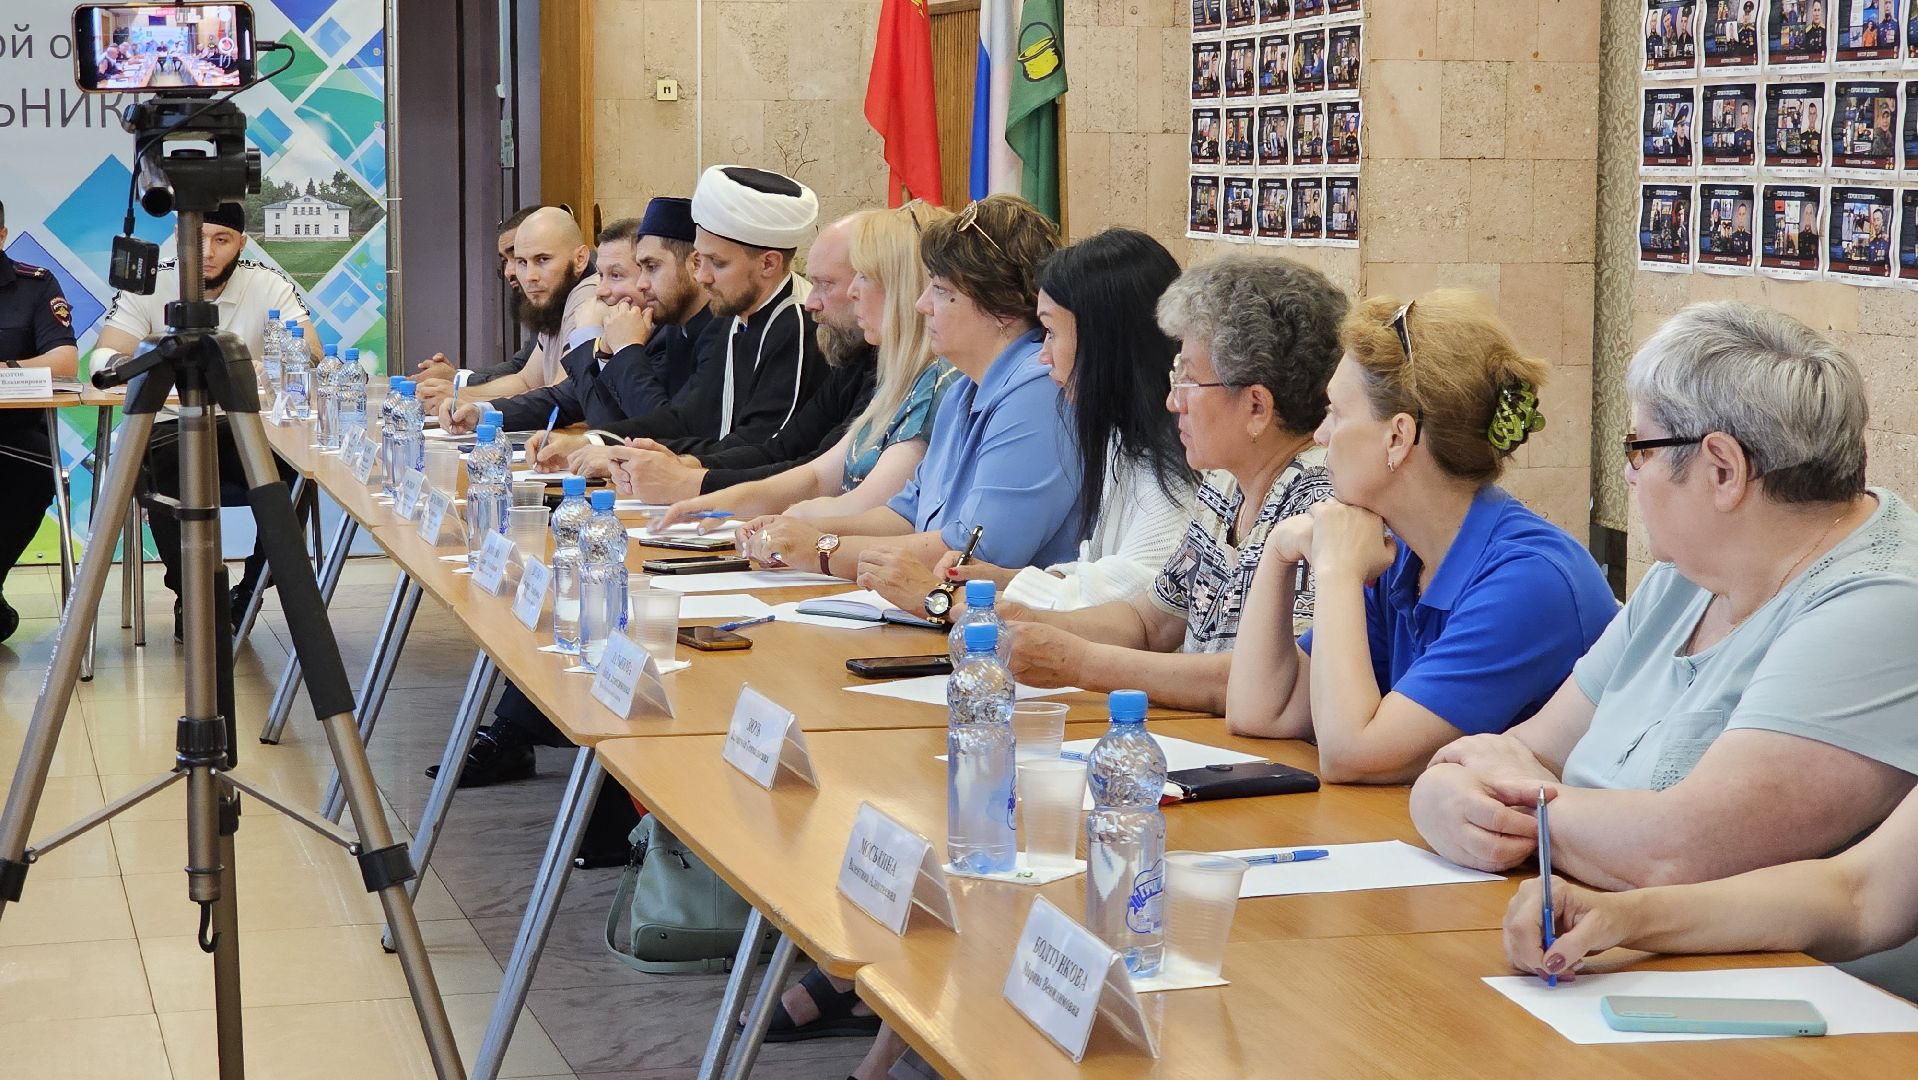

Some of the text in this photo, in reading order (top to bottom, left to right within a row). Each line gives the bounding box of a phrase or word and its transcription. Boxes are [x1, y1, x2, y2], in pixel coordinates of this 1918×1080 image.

[0, 24, 33, 58] й
[0, 88, 139, 128] ЬНИК
[1032, 936, 1089, 992] БОЛТУНКОВА
